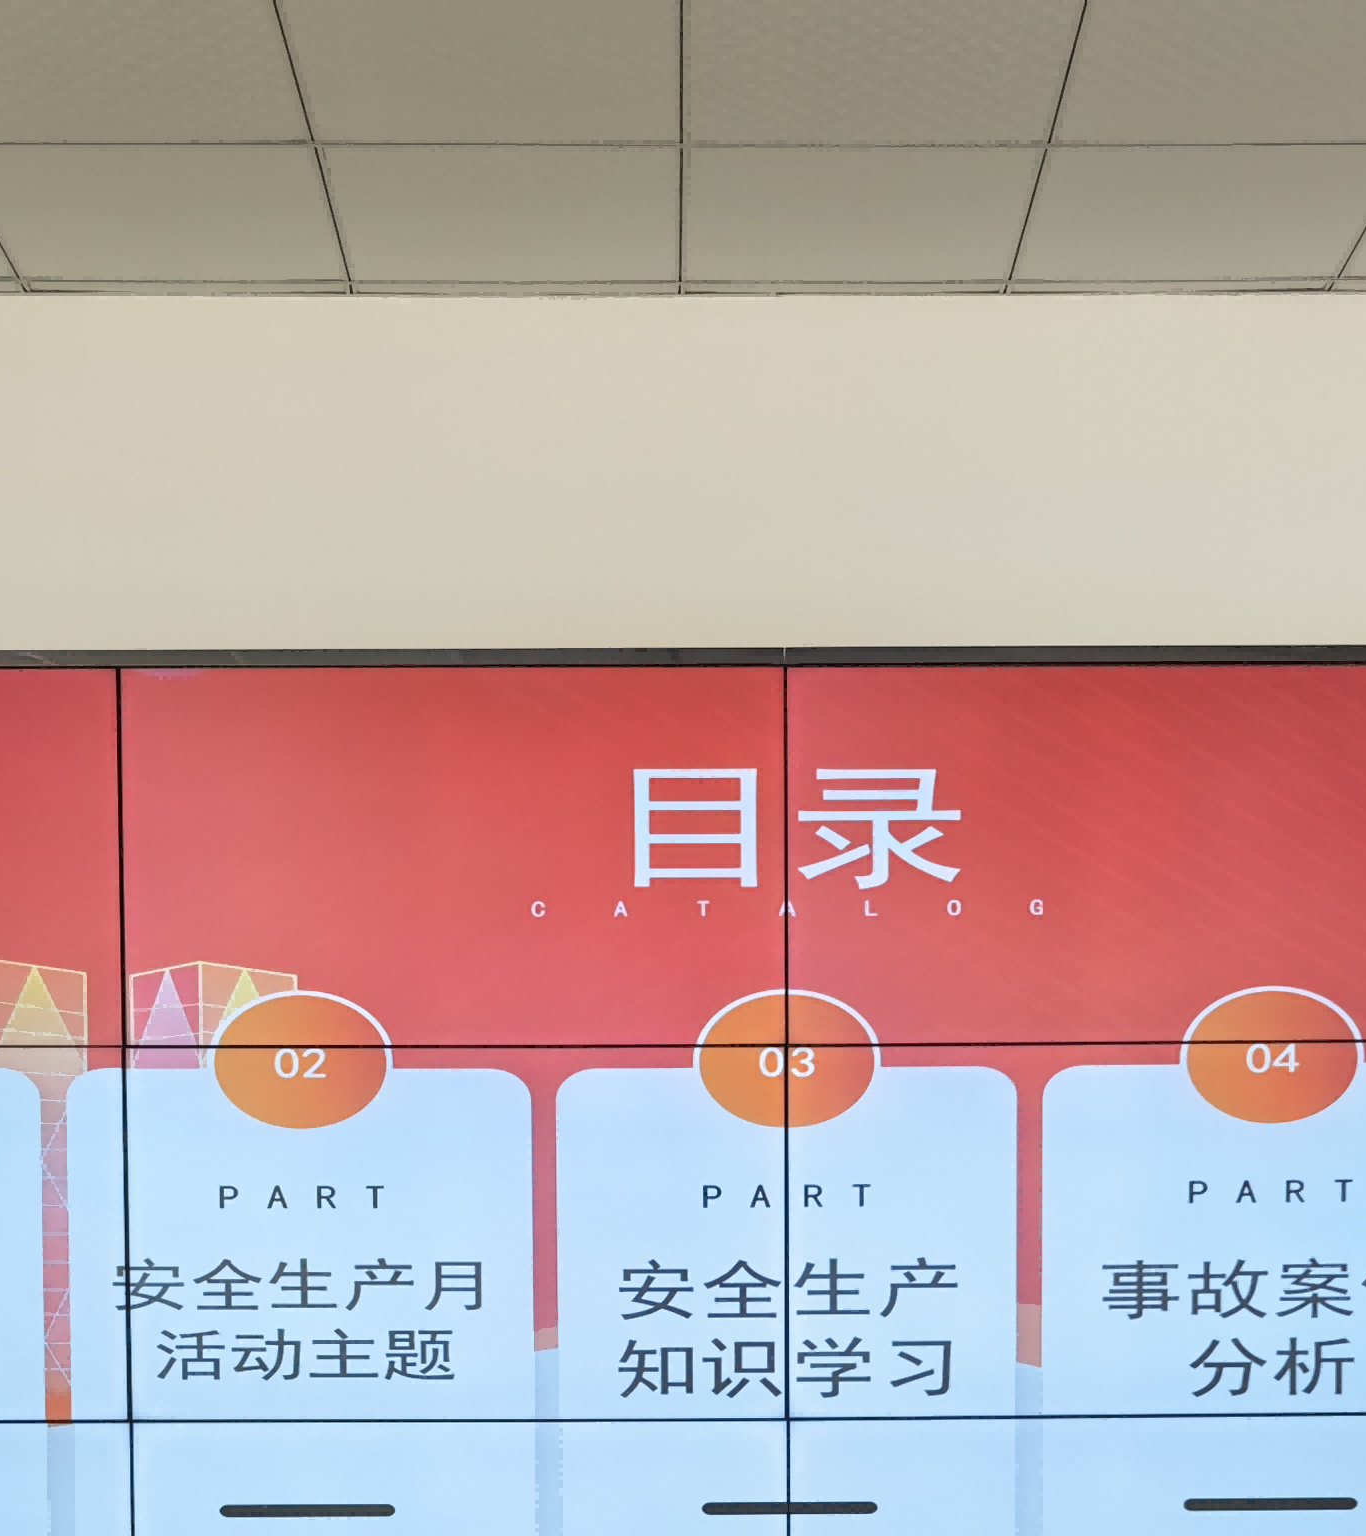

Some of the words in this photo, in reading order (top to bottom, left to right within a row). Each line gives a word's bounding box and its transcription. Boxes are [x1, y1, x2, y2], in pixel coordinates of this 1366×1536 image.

[633, 767, 962, 890] 目录
[530, 899, 1044, 917] CATALOG
[274, 1048, 327, 1079] 02
[758, 1047, 816, 1078] 03
[1246, 1043, 1300, 1074] 04
[219, 1185, 384, 1209] PART
[702, 1183, 871, 1209] PART
[1188, 1179, 1353, 1204] PART
[111, 1257, 485, 1312] 安全生产月
[618, 1256, 958, 1321] 安全生产
[157, 1328, 456, 1382] 活动主题
[618, 1337, 953, 1400] 知识学习
[1190, 1337, 1356, 1398] 分析
